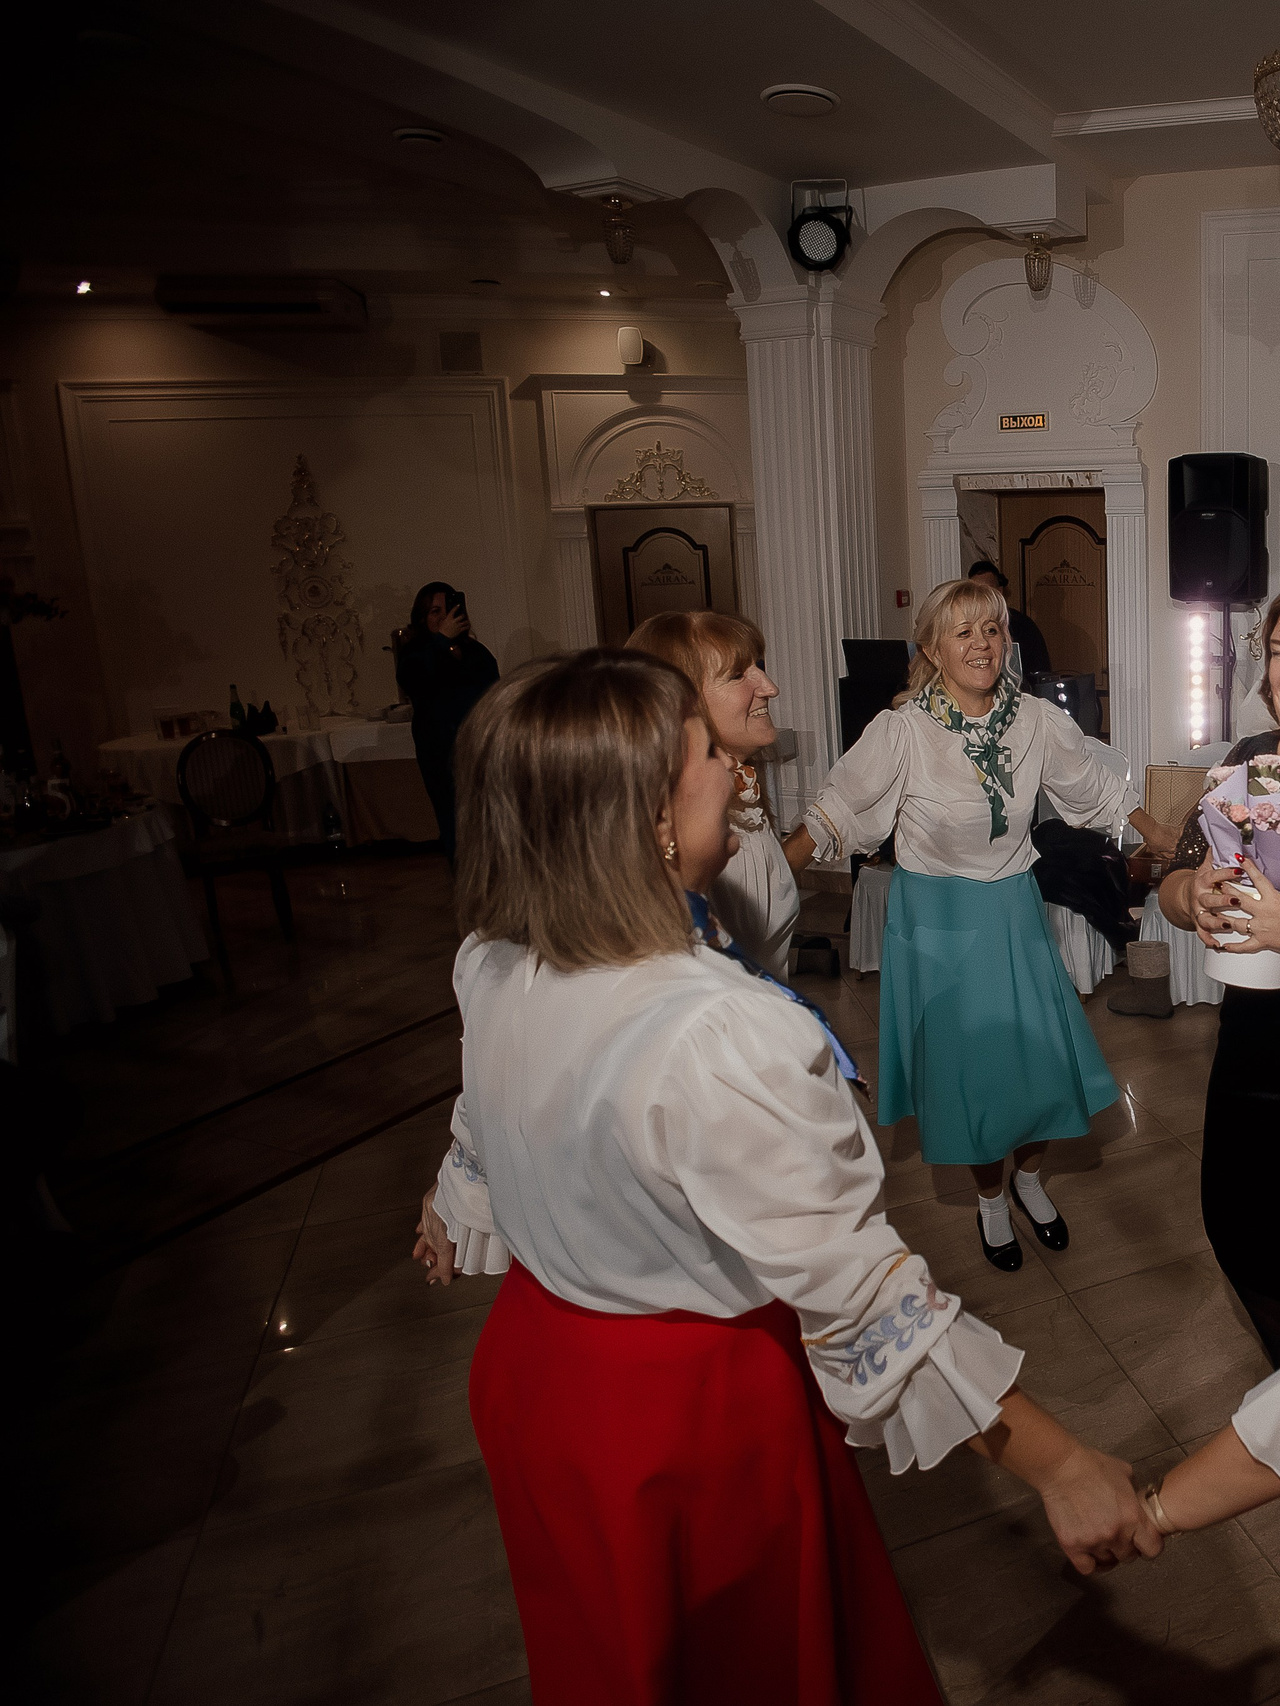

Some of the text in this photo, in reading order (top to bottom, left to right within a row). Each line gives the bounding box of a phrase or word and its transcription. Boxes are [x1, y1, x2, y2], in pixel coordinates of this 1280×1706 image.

[1002, 415, 1043, 428] ВЫХОД
[648, 575, 688, 584] SAIRAN
[1044, 574, 1087, 584] SAIRAN
